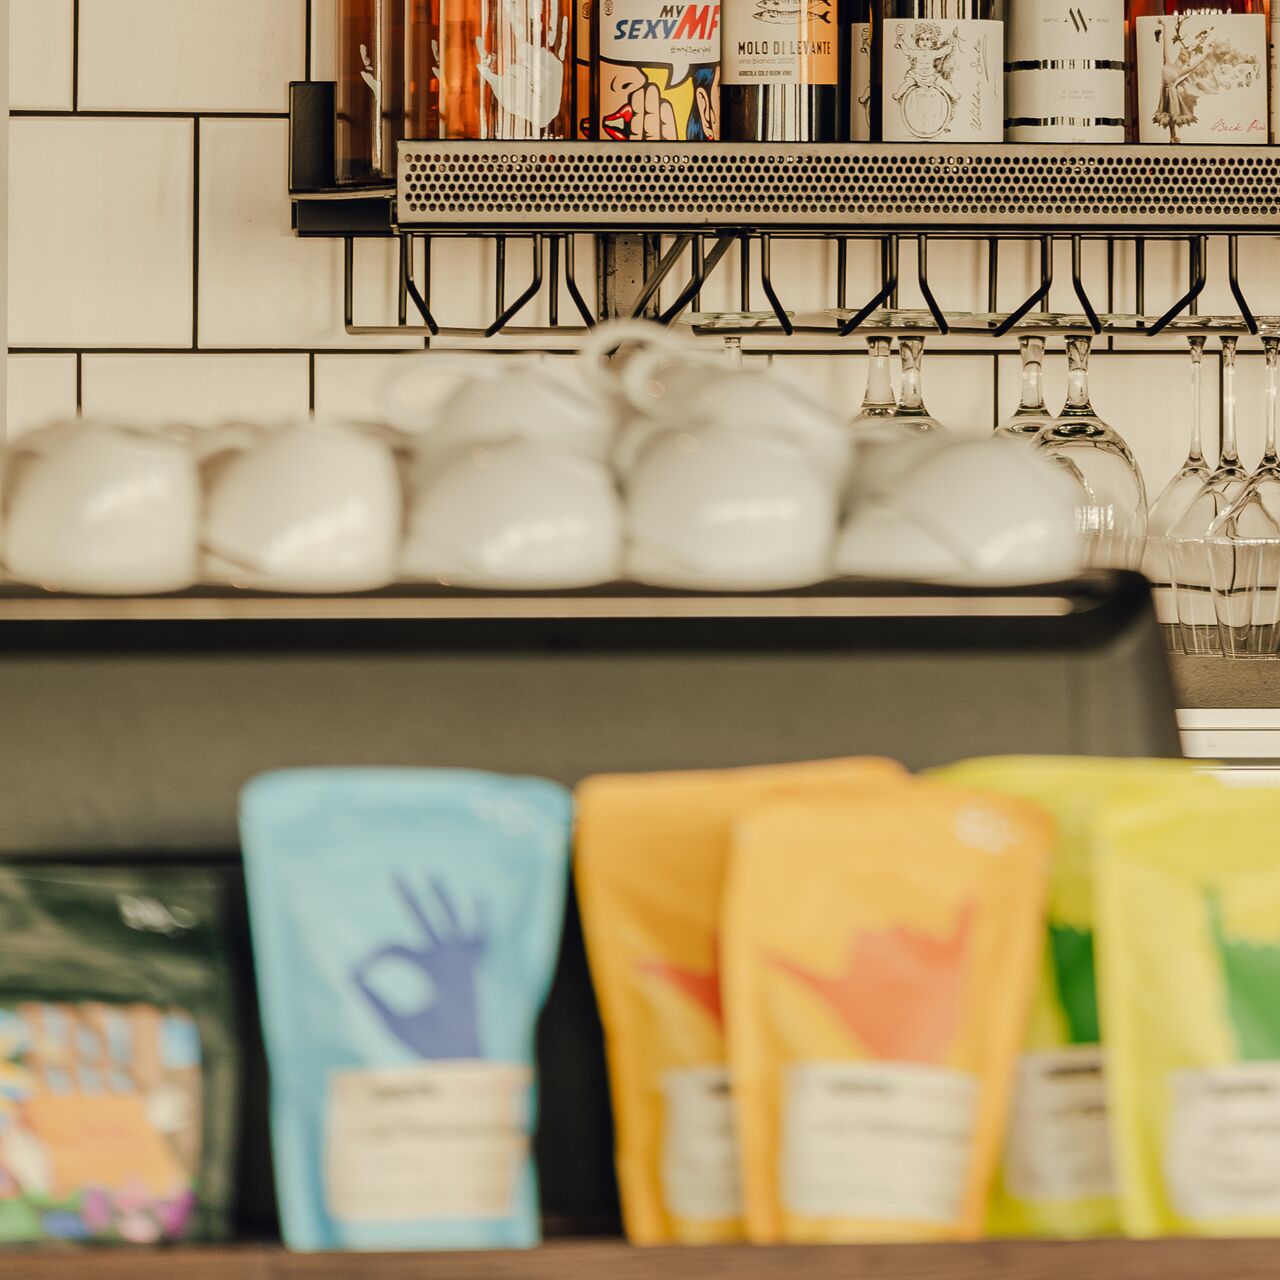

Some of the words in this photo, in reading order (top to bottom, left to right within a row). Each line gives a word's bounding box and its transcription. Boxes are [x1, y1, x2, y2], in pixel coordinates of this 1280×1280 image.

[660, 5, 685, 18] MY
[614, 19, 678, 40] SEXY
[738, 41, 768, 55] MOLO
[773, 41, 785, 55] DI
[790, 41, 831, 55] LEVANTE
